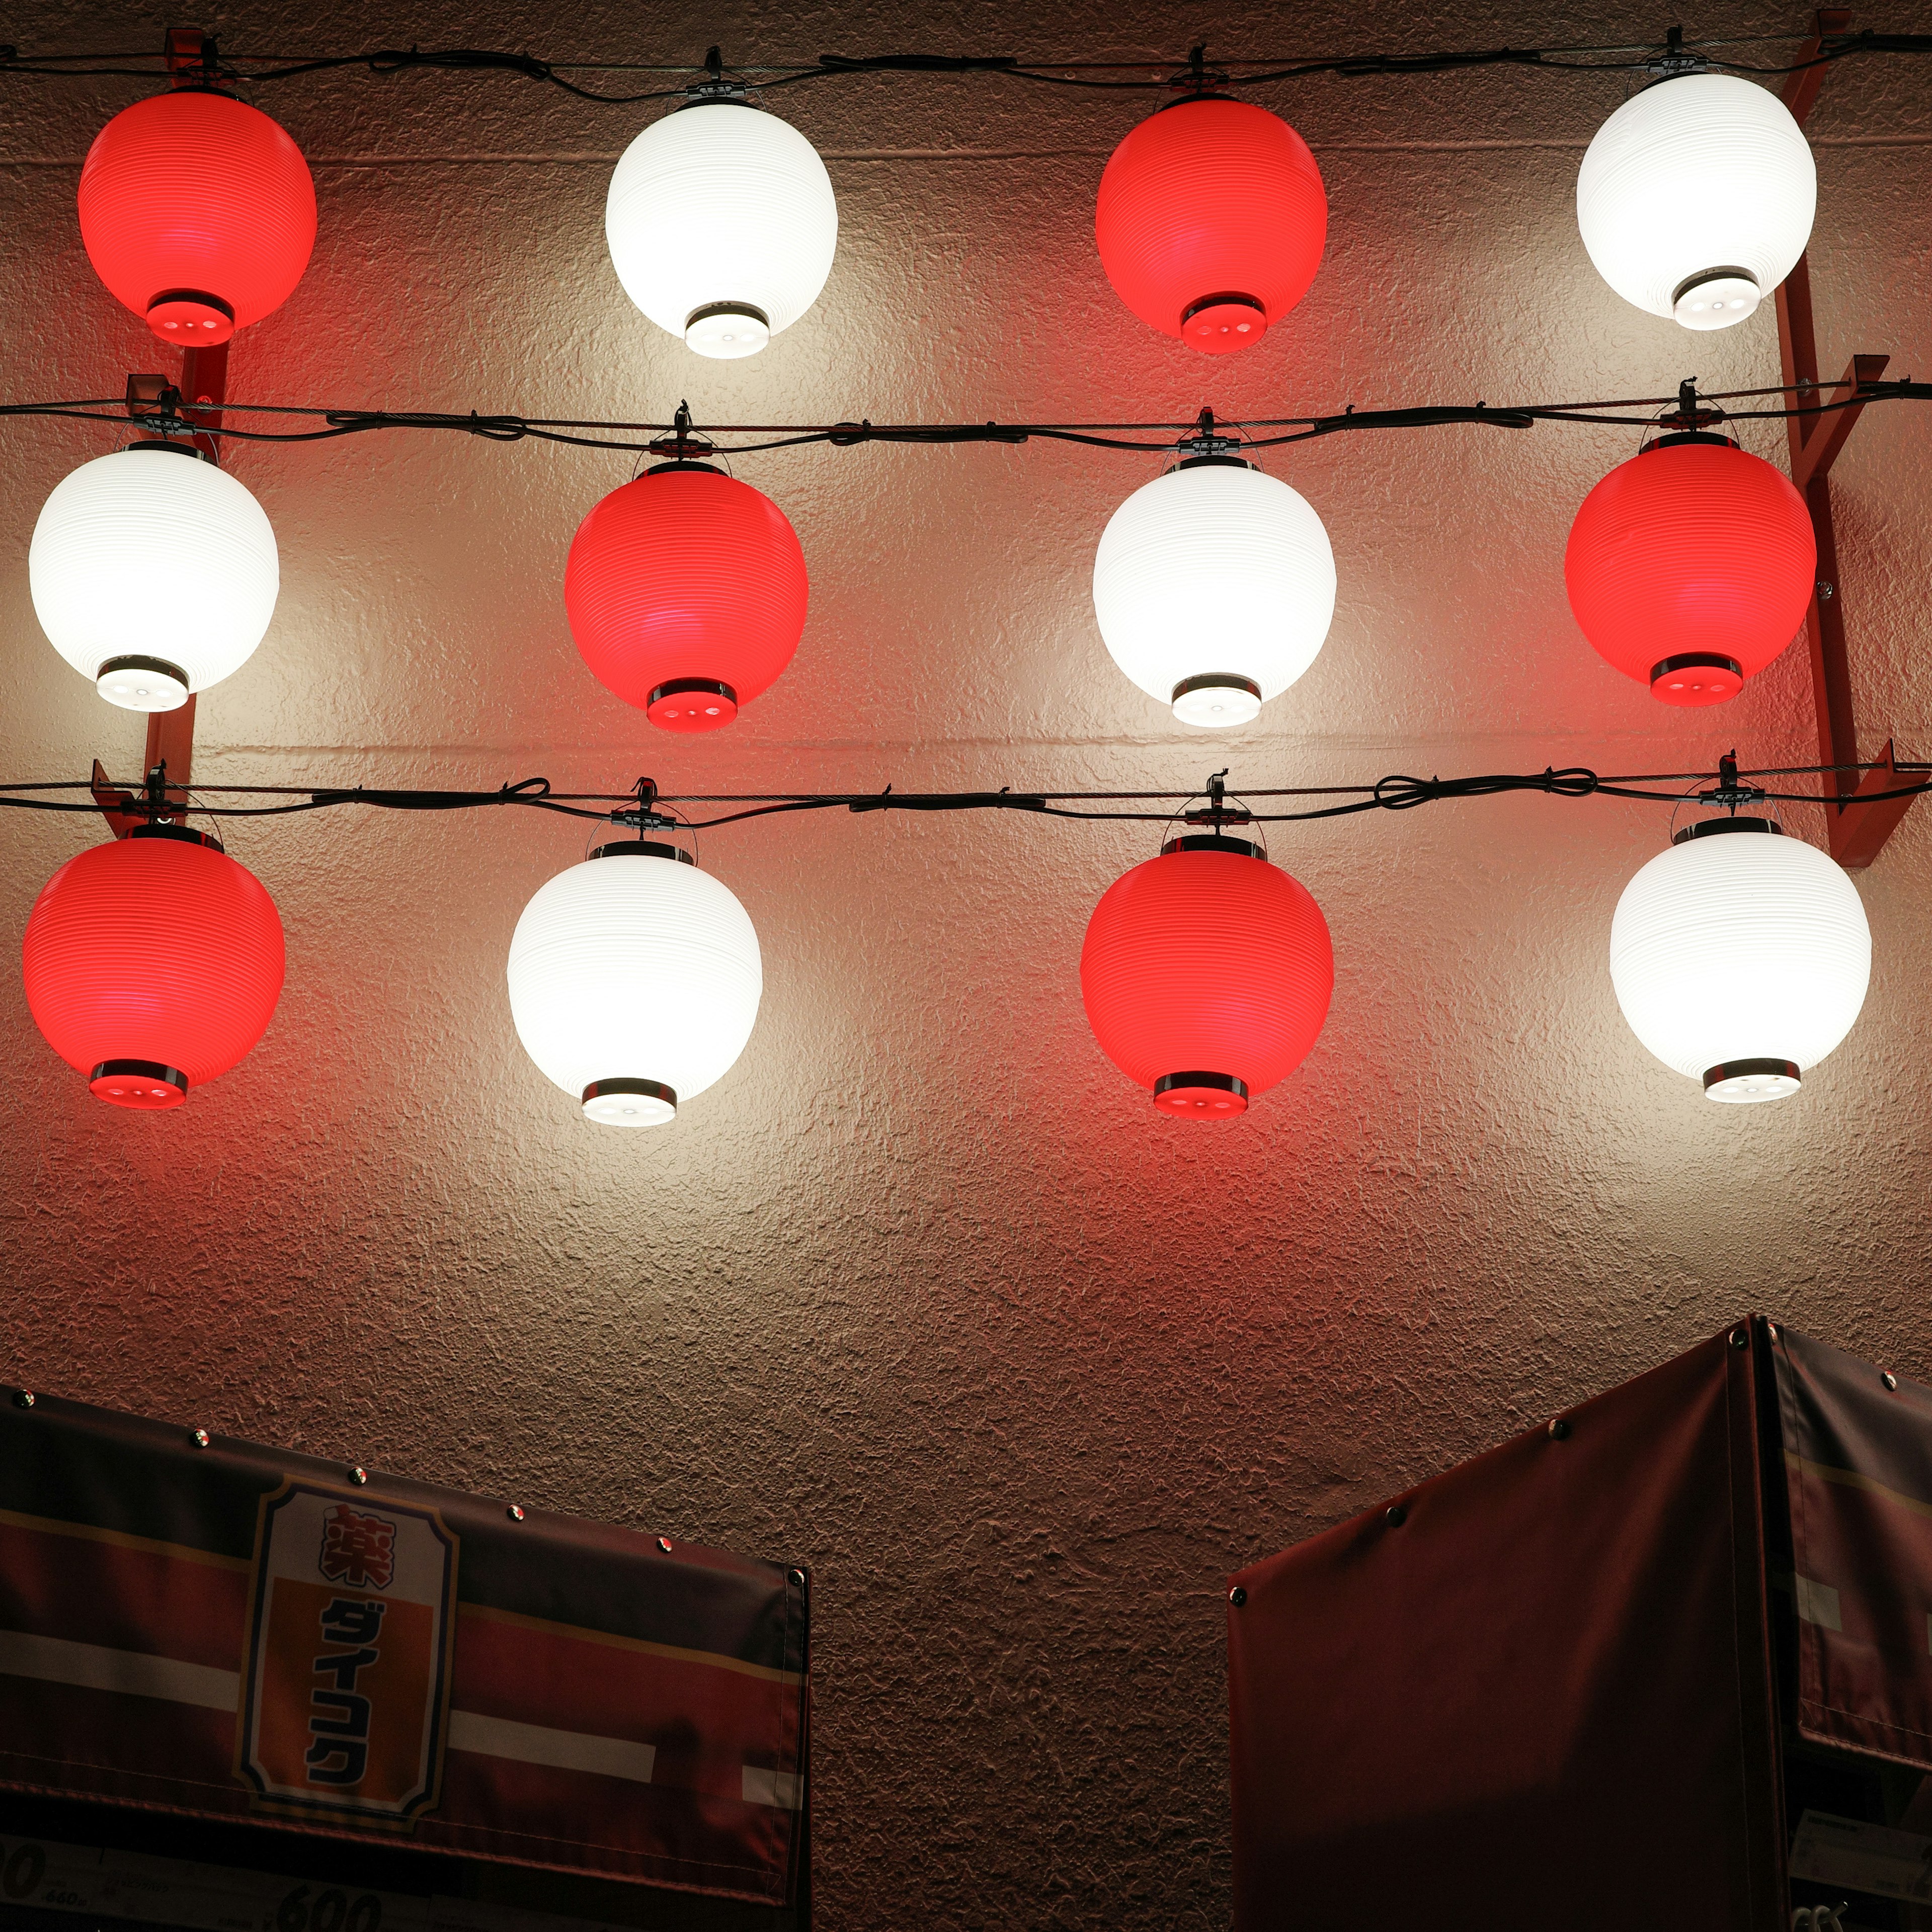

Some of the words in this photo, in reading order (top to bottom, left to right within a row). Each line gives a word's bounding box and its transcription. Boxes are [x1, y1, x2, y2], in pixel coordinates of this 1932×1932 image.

[320, 1504, 395, 1589] 薬
[305, 1598, 385, 1785] ダイコク
